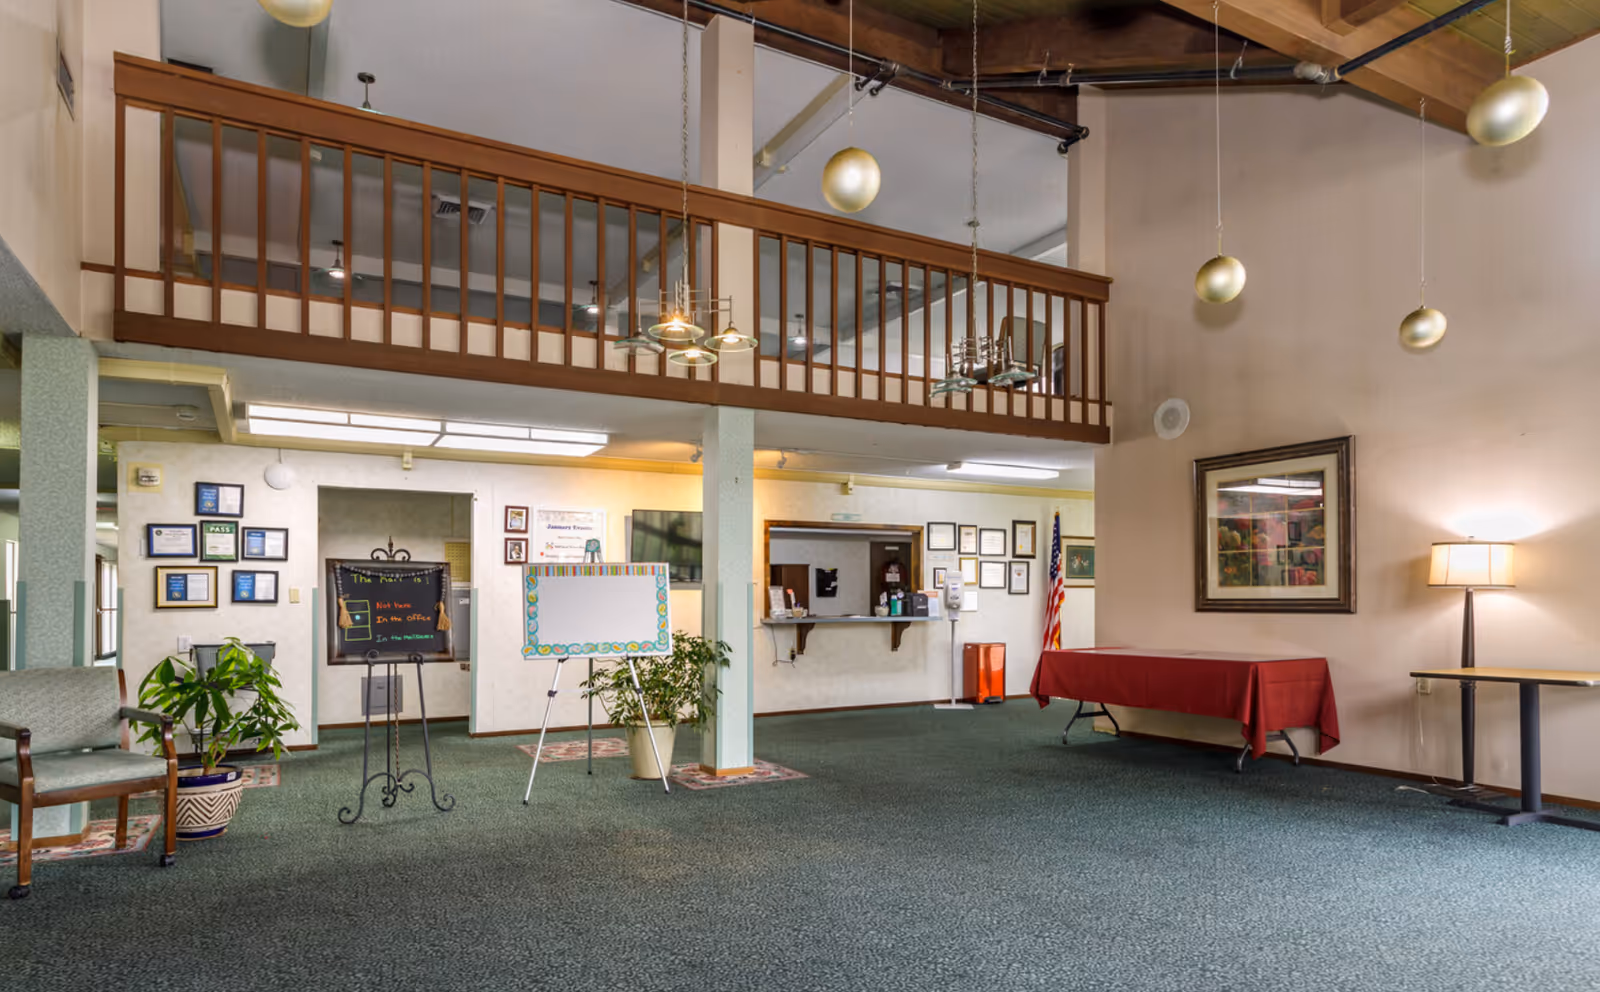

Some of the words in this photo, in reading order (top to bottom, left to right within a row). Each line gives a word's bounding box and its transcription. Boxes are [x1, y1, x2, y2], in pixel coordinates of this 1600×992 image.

[350, 574, 372, 583] The
[376, 615, 388, 623] In
[376, 634, 388, 642] In
